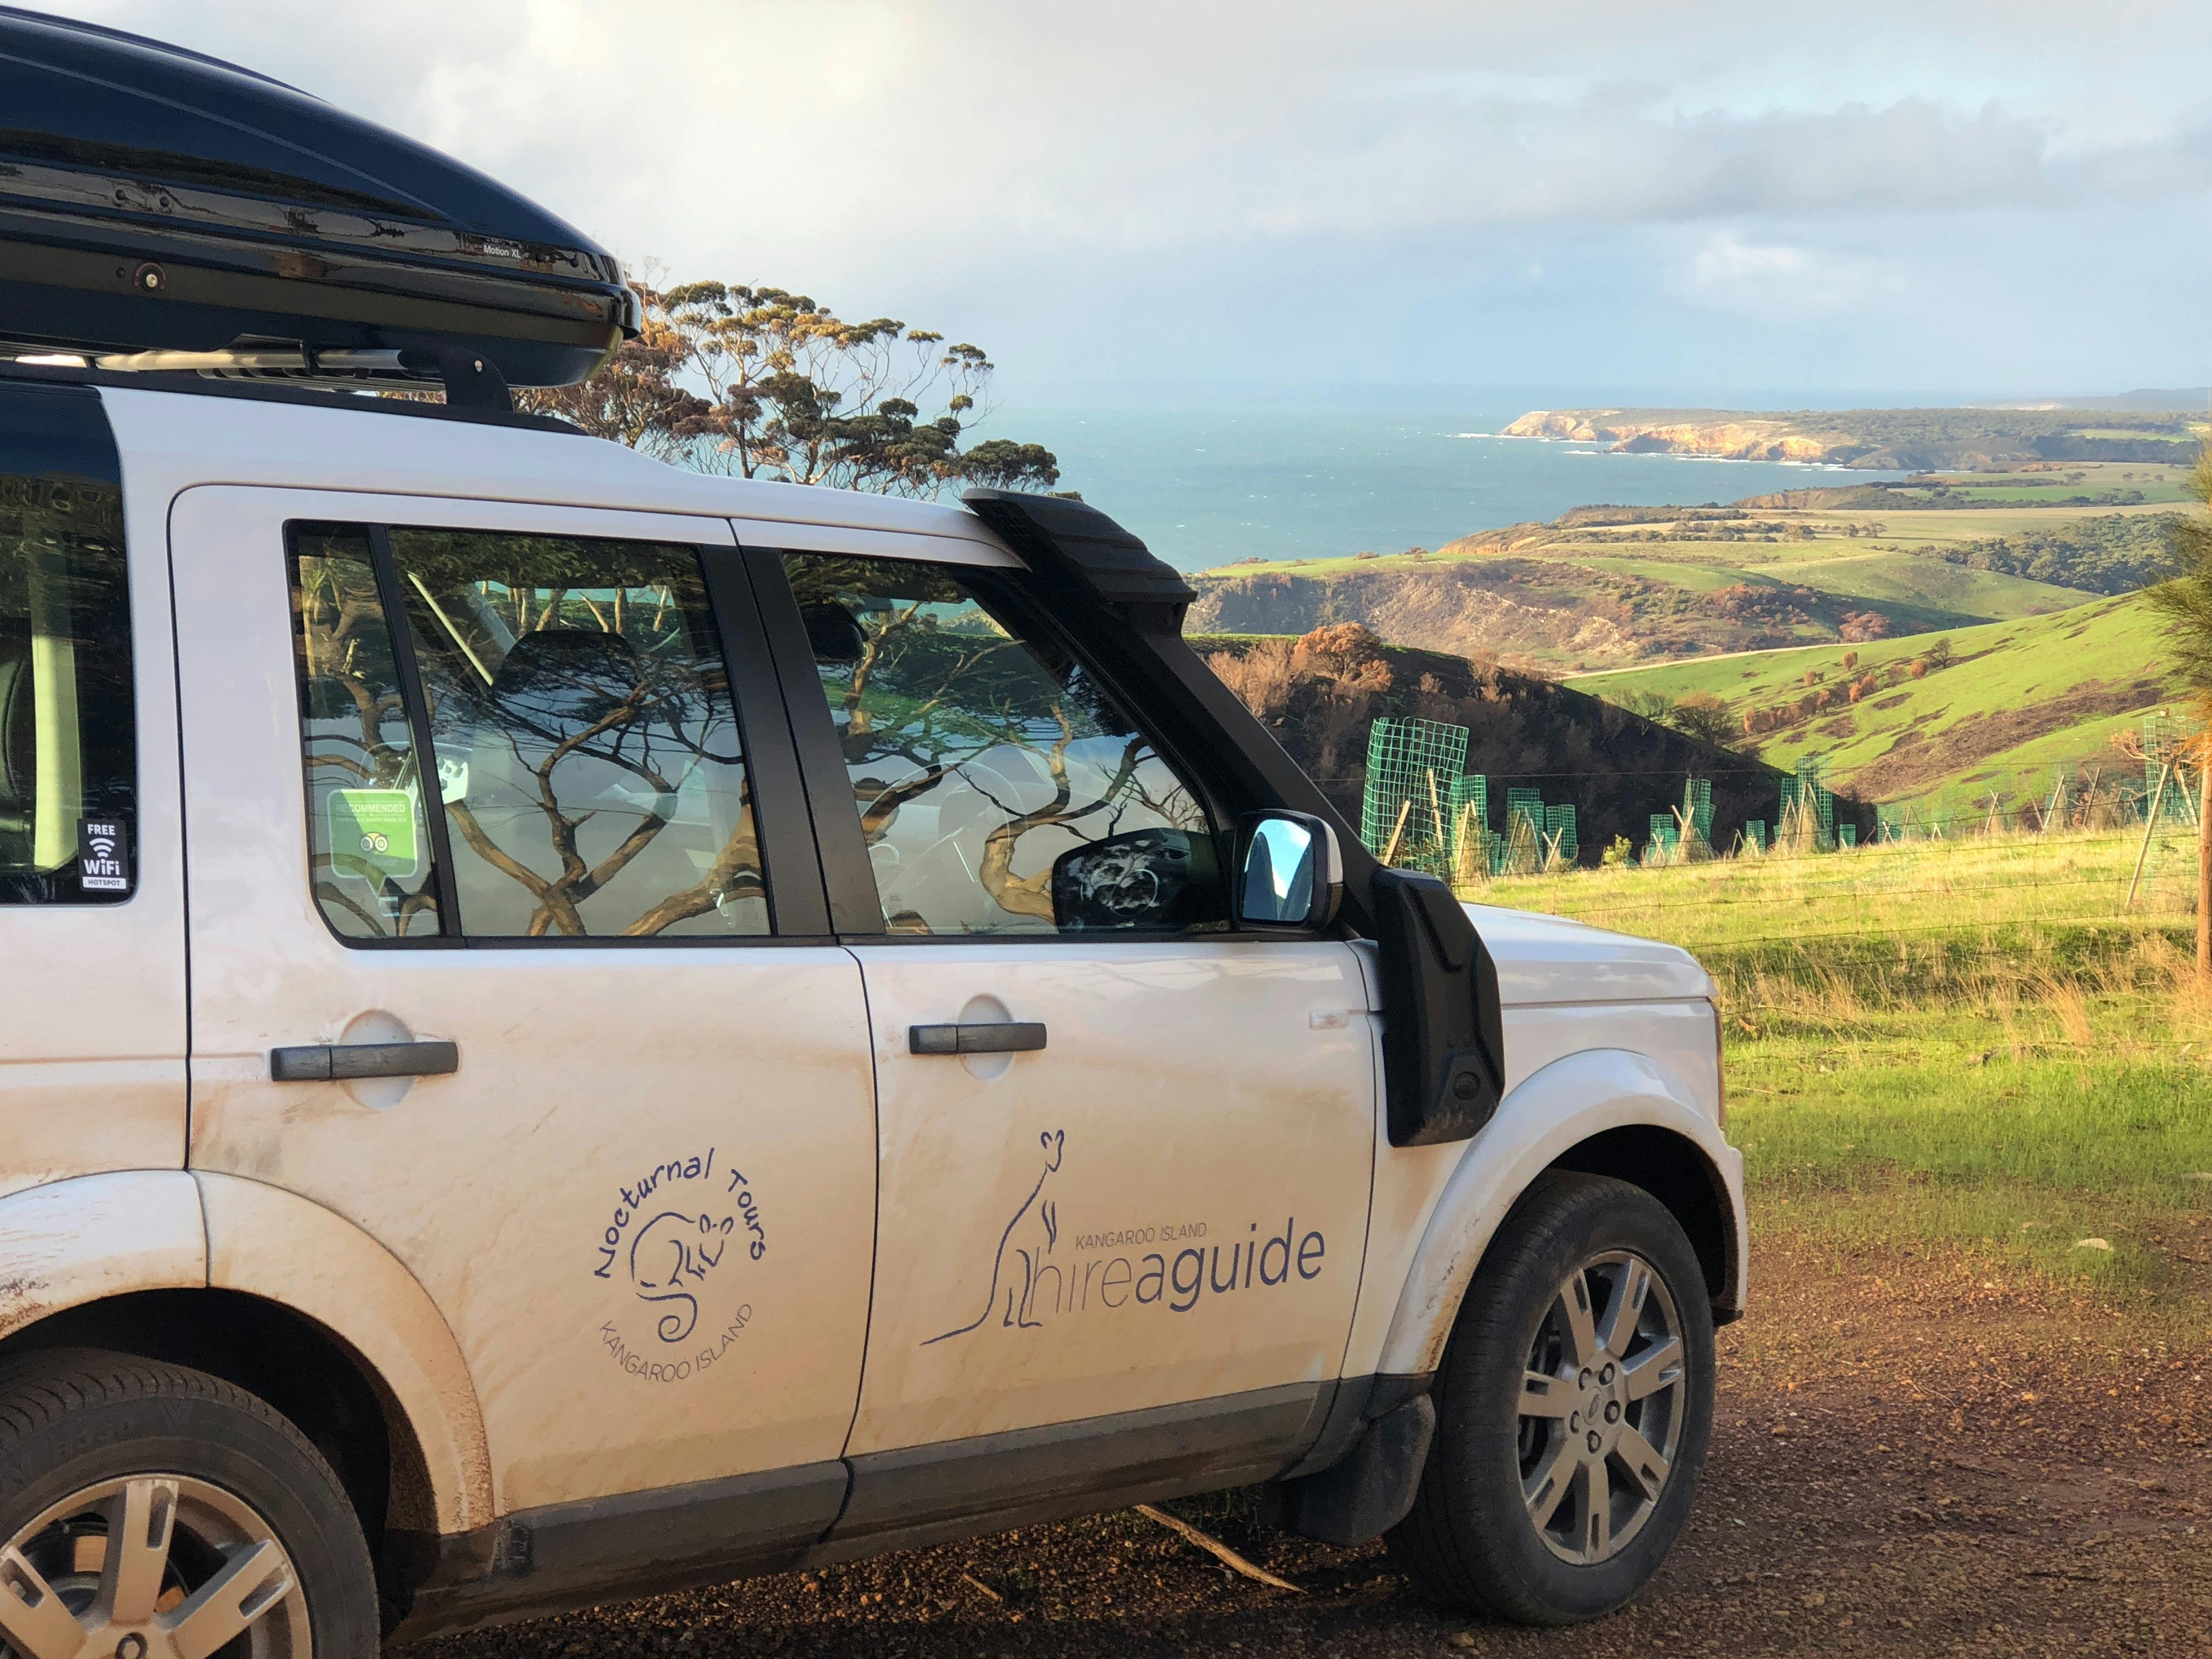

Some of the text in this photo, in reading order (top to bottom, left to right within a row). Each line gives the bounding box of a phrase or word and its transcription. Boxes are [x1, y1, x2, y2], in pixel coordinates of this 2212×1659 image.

[483, 244, 521, 258] Motion XL
[336, 803, 405, 812] RECOMMENDED
[87, 823, 116, 836] FREE
[83, 859, 120, 876] WiFi
[594, 1147, 766, 1278] Nocturnal Tours
[1075, 1222, 1207, 1250] KANGAROO ISLAND
[599, 1304, 752, 1383] KANGAROO ISLAND
